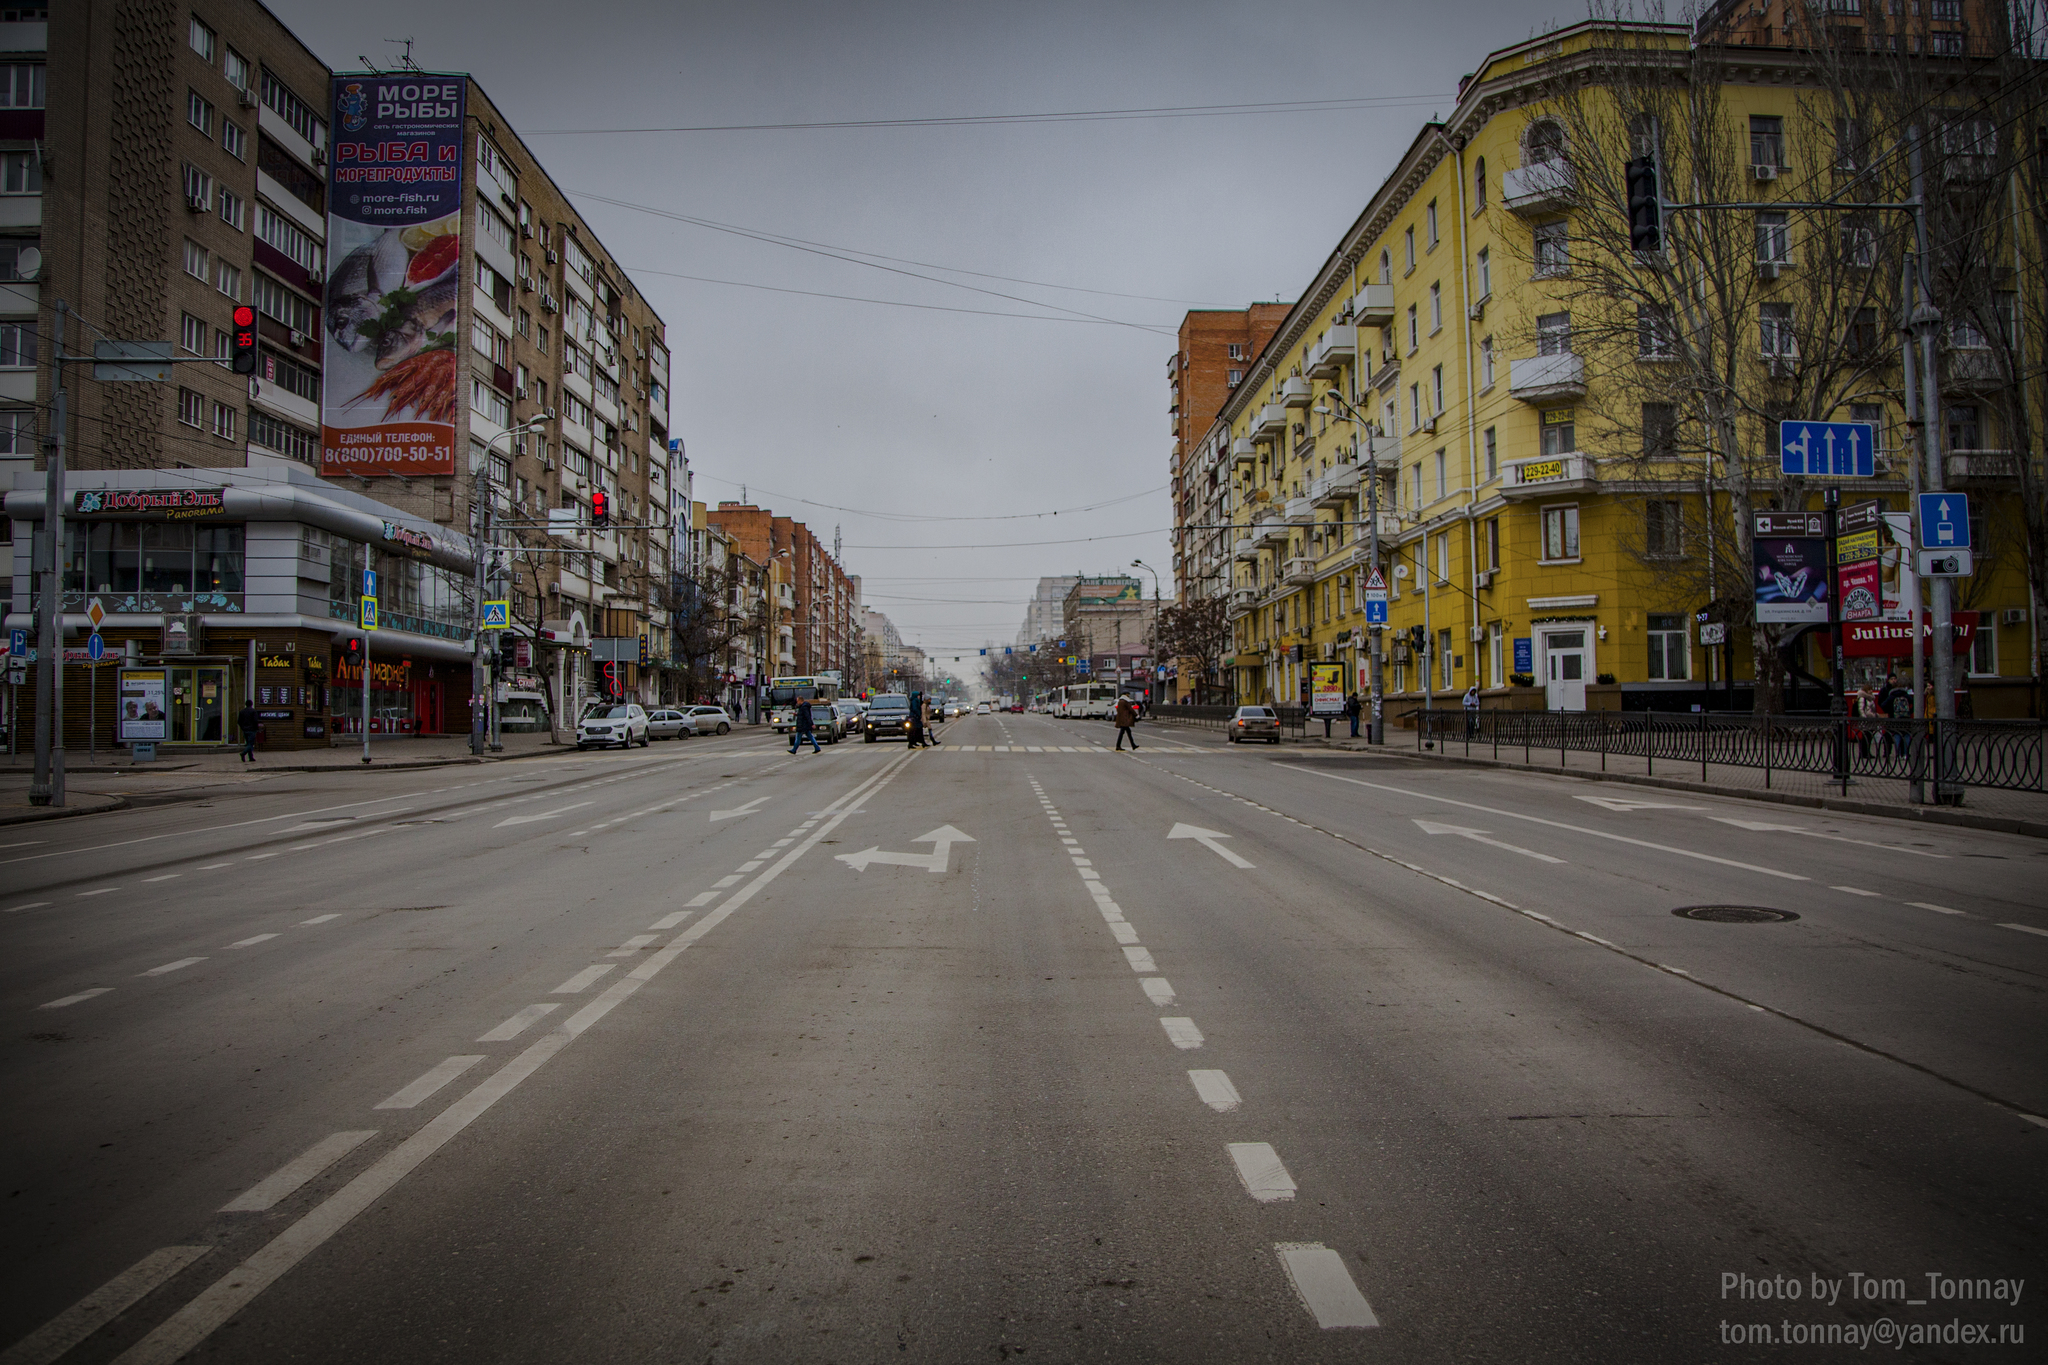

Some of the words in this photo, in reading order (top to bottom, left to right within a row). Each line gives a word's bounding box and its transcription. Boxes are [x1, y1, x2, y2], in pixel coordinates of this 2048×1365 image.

[378, 85, 458, 101] МОРЕ
[377, 103, 458, 119] РЫБЫ
[337, 142, 429, 163] РЫБА
[335, 166, 456, 183] МОРЕПРОДУКТЫ
[362, 193, 440, 203] more-fish.ru
[373, 206, 427, 215] more.fish
[238, 332, 253, 346] 35
[339, 431, 382, 445] ЕДИНЫЙ
[385, 432, 436, 443] ТЕЛЕФОН:
[324, 446, 450, 464] 8(800)700-50-51
[1526, 463, 1560, 477] 229-22-40
[103, 490, 183, 511] Добрый
[184, 489, 220, 506] Эль
[1852, 625, 1914, 640] Julius
[260, 655, 290, 668] Табак
[307, 656, 322, 669] Табак
